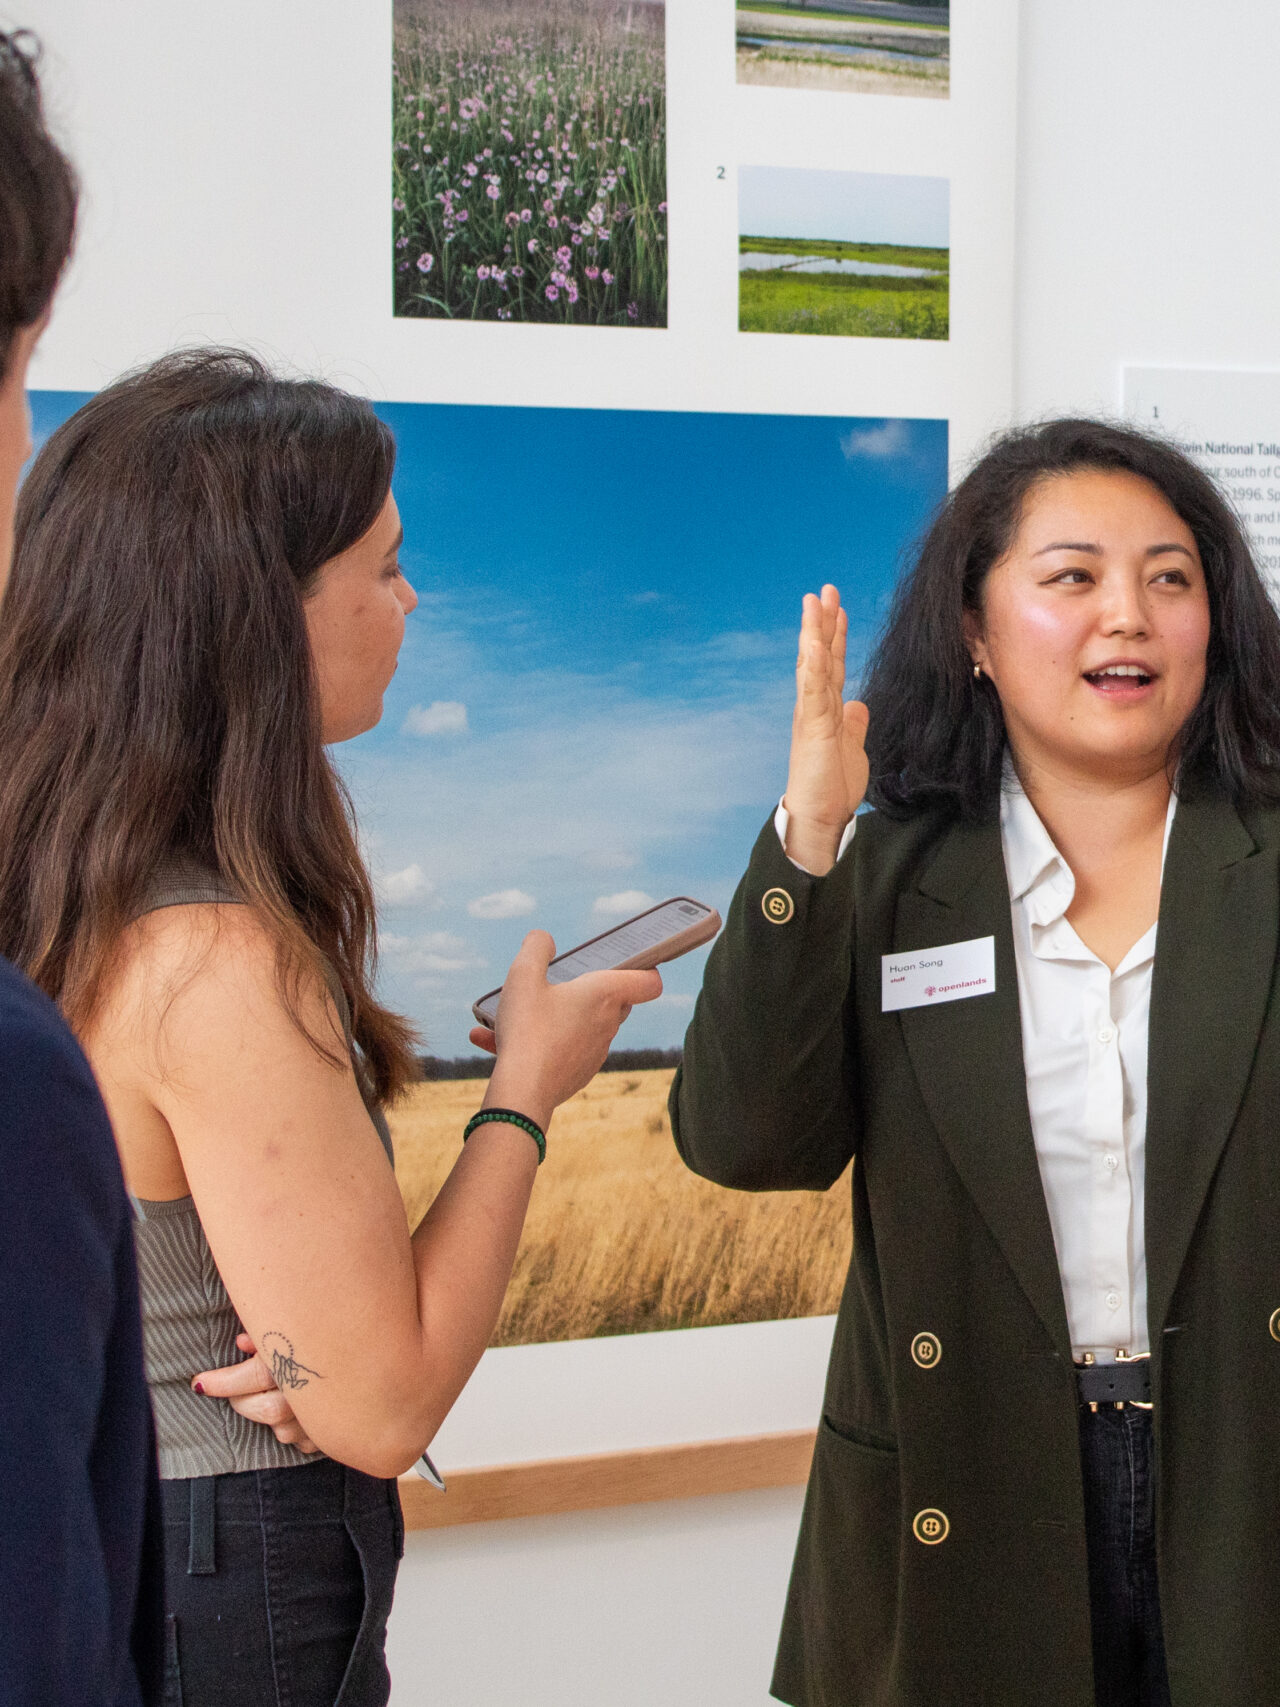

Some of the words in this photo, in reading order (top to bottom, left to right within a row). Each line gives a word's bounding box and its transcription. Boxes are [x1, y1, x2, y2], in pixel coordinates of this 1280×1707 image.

[716, 165, 726, 180] 2
[1153, 406, 1159, 418] 1
[1206, 443, 1254, 454] National
[1224, 466, 1256, 478] south
[1259, 467, 1271, 478] of
[1254, 511, 1275, 522] and
[889, 964, 916, 974] Huan
[919, 959, 944, 970] Song
[938, 977, 987, 993] openlands
